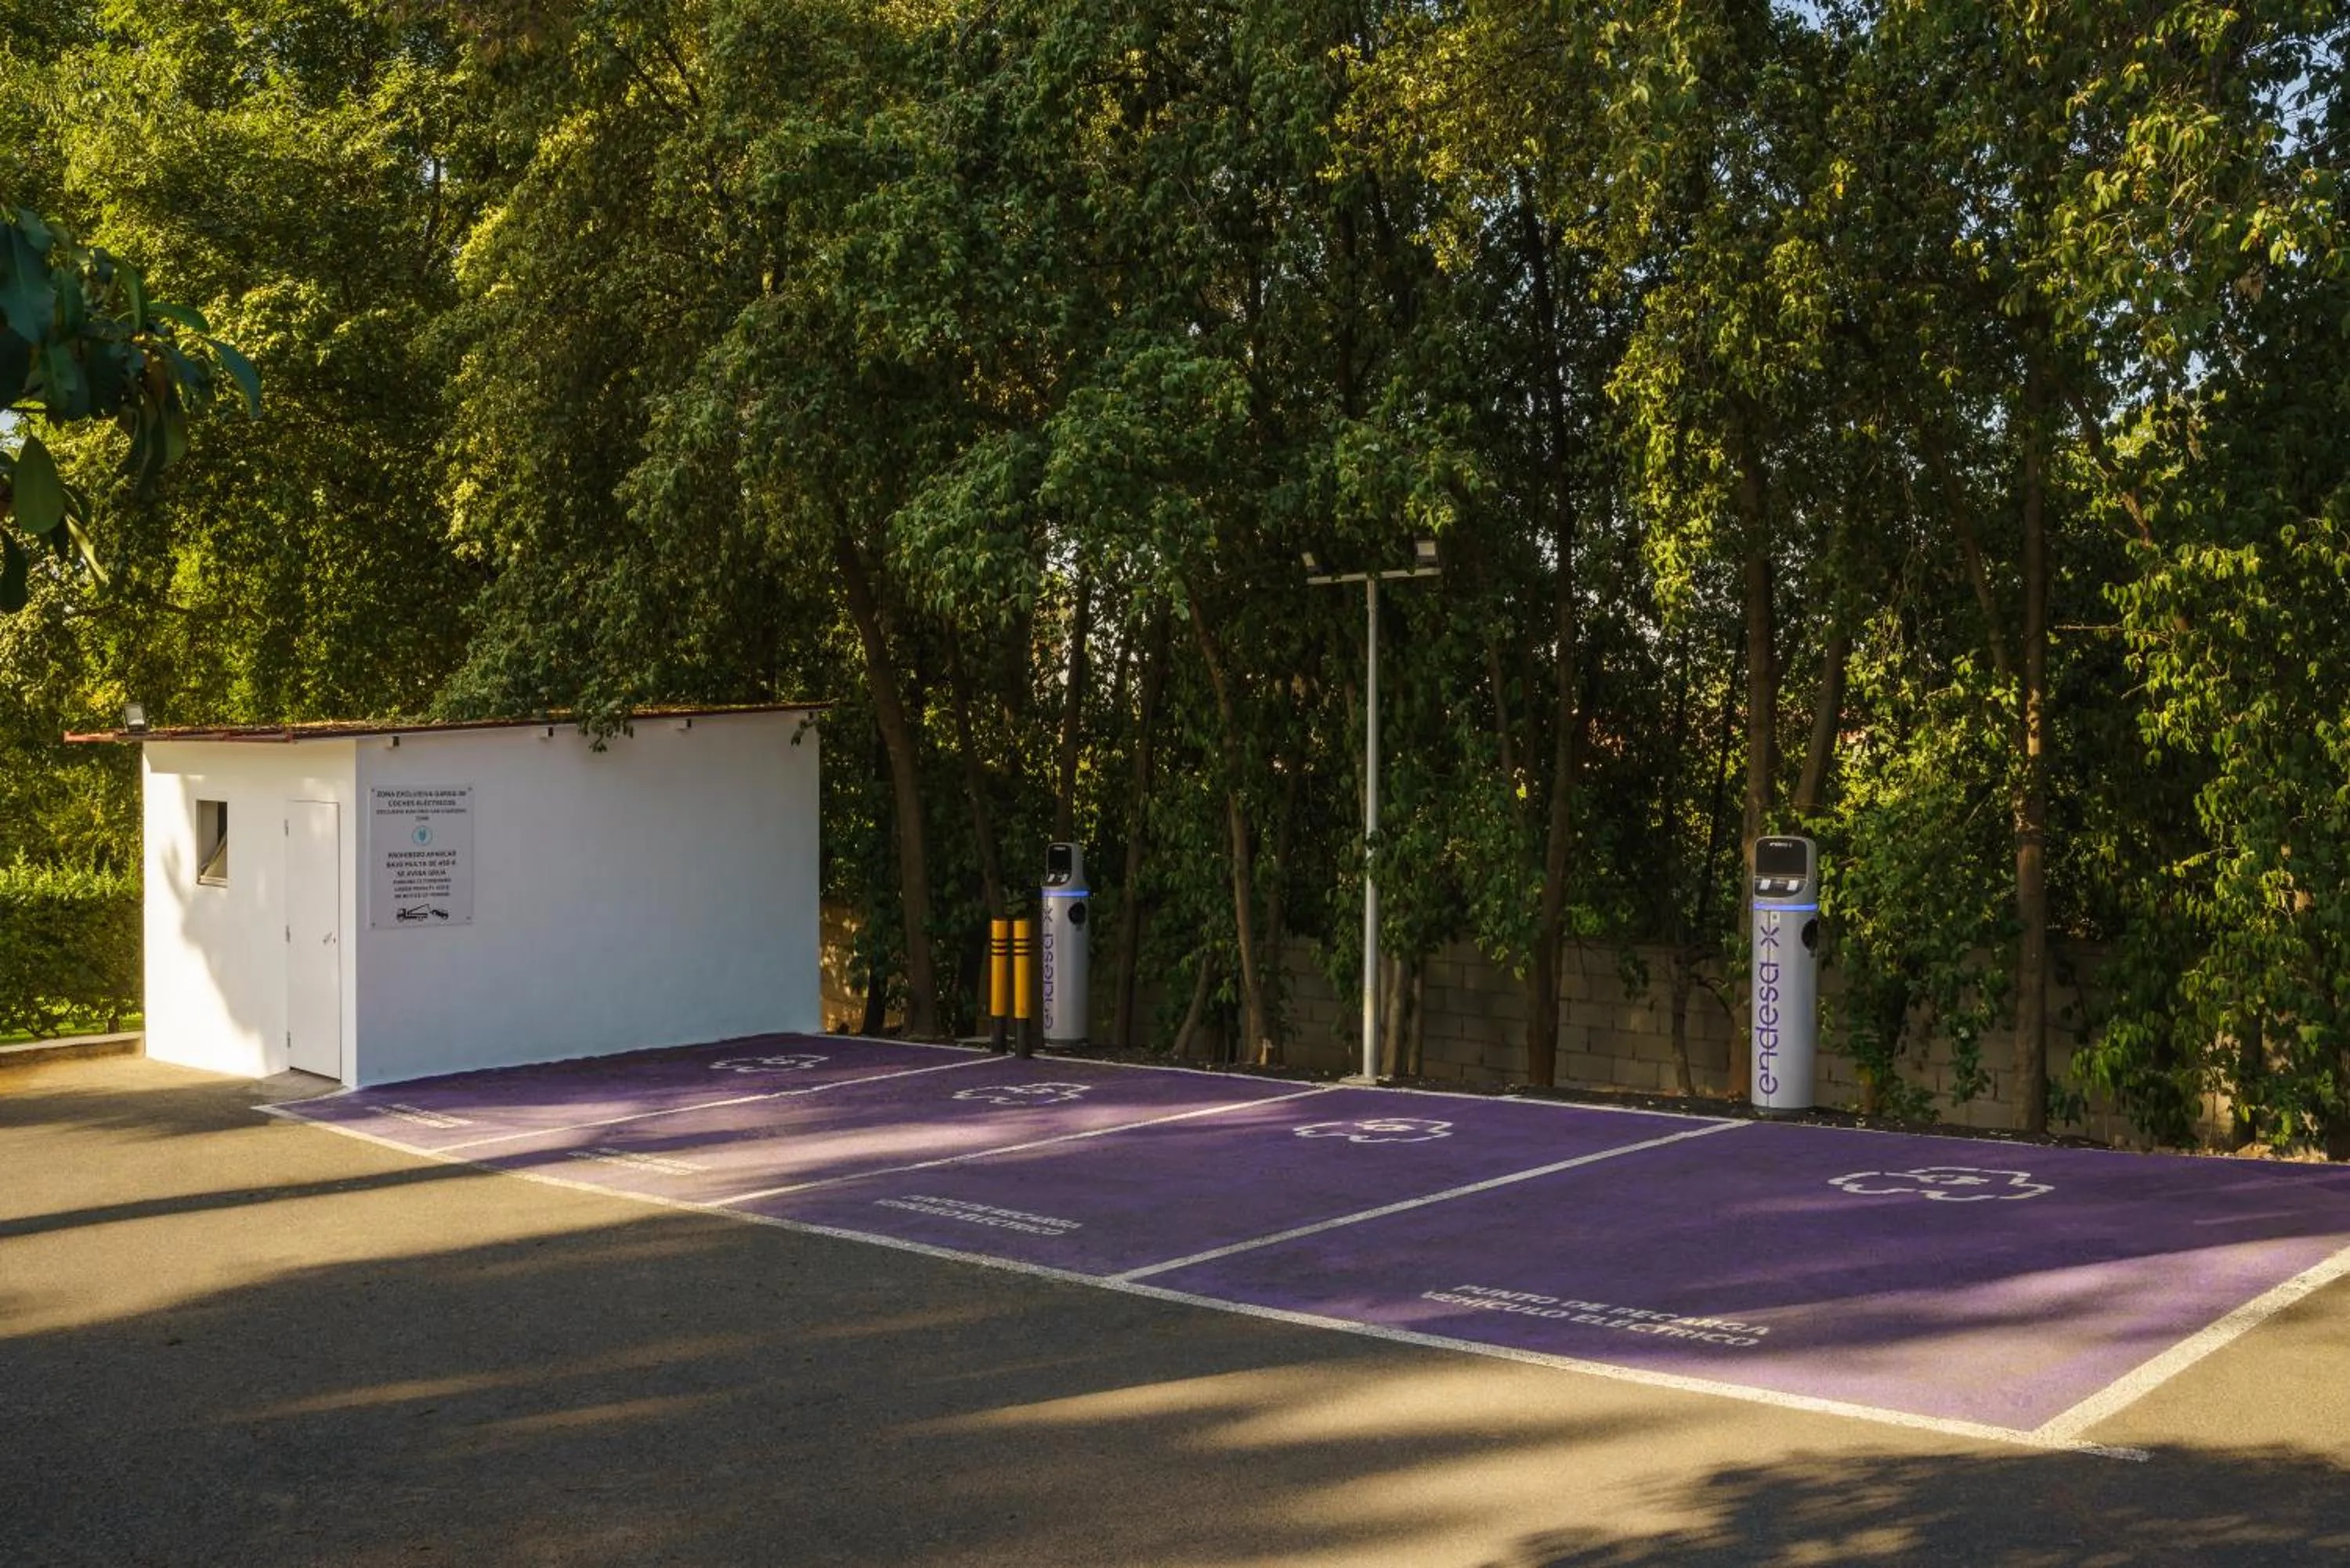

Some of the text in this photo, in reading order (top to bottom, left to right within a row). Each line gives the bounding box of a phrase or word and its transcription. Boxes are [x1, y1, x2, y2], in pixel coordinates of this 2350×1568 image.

[1755, 962, 1780, 1096] endesa
[1452, 1284, 1559, 1305] PUNTO
[1560, 1299, 1611, 1312] DE
